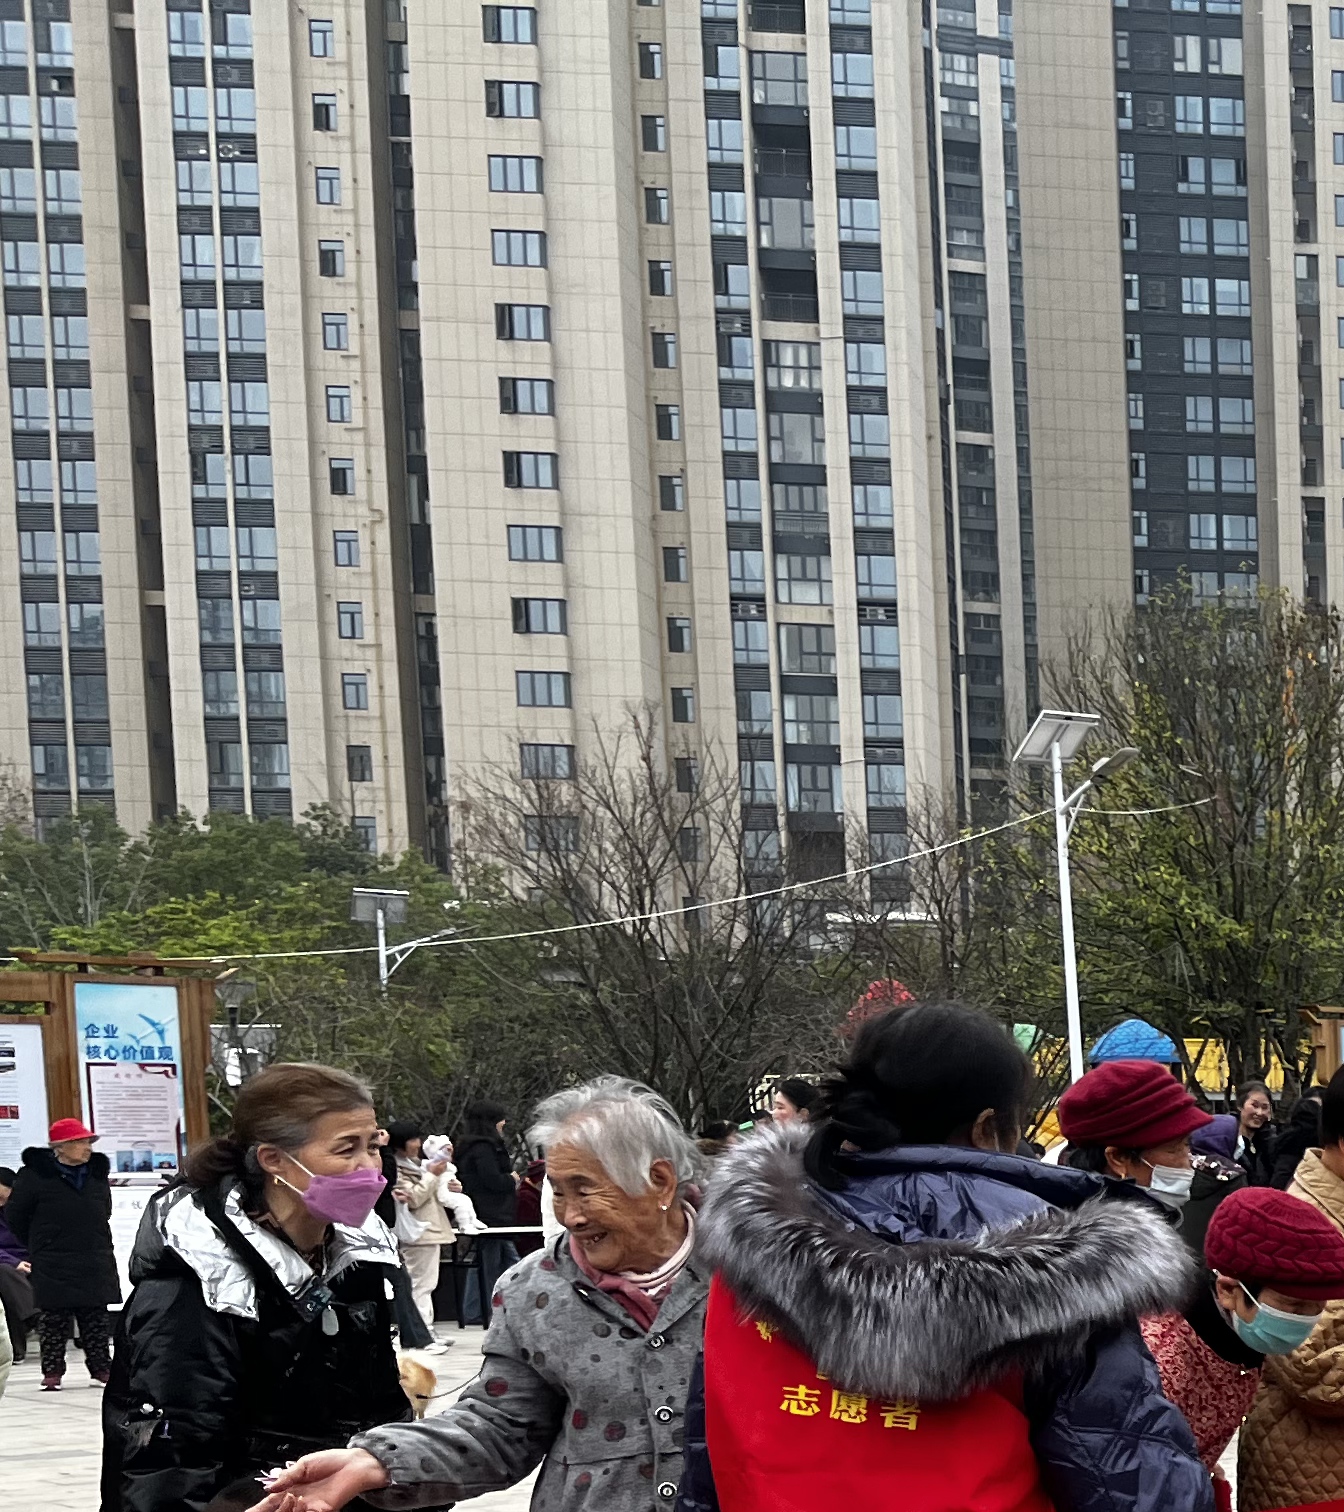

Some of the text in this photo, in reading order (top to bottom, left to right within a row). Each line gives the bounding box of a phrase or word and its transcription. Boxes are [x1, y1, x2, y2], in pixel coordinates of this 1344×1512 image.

[84, 1023, 119, 1039] 企业
[86, 1044, 175, 1062] 核心价值观
[779, 1384, 922, 1431] 志愿者
